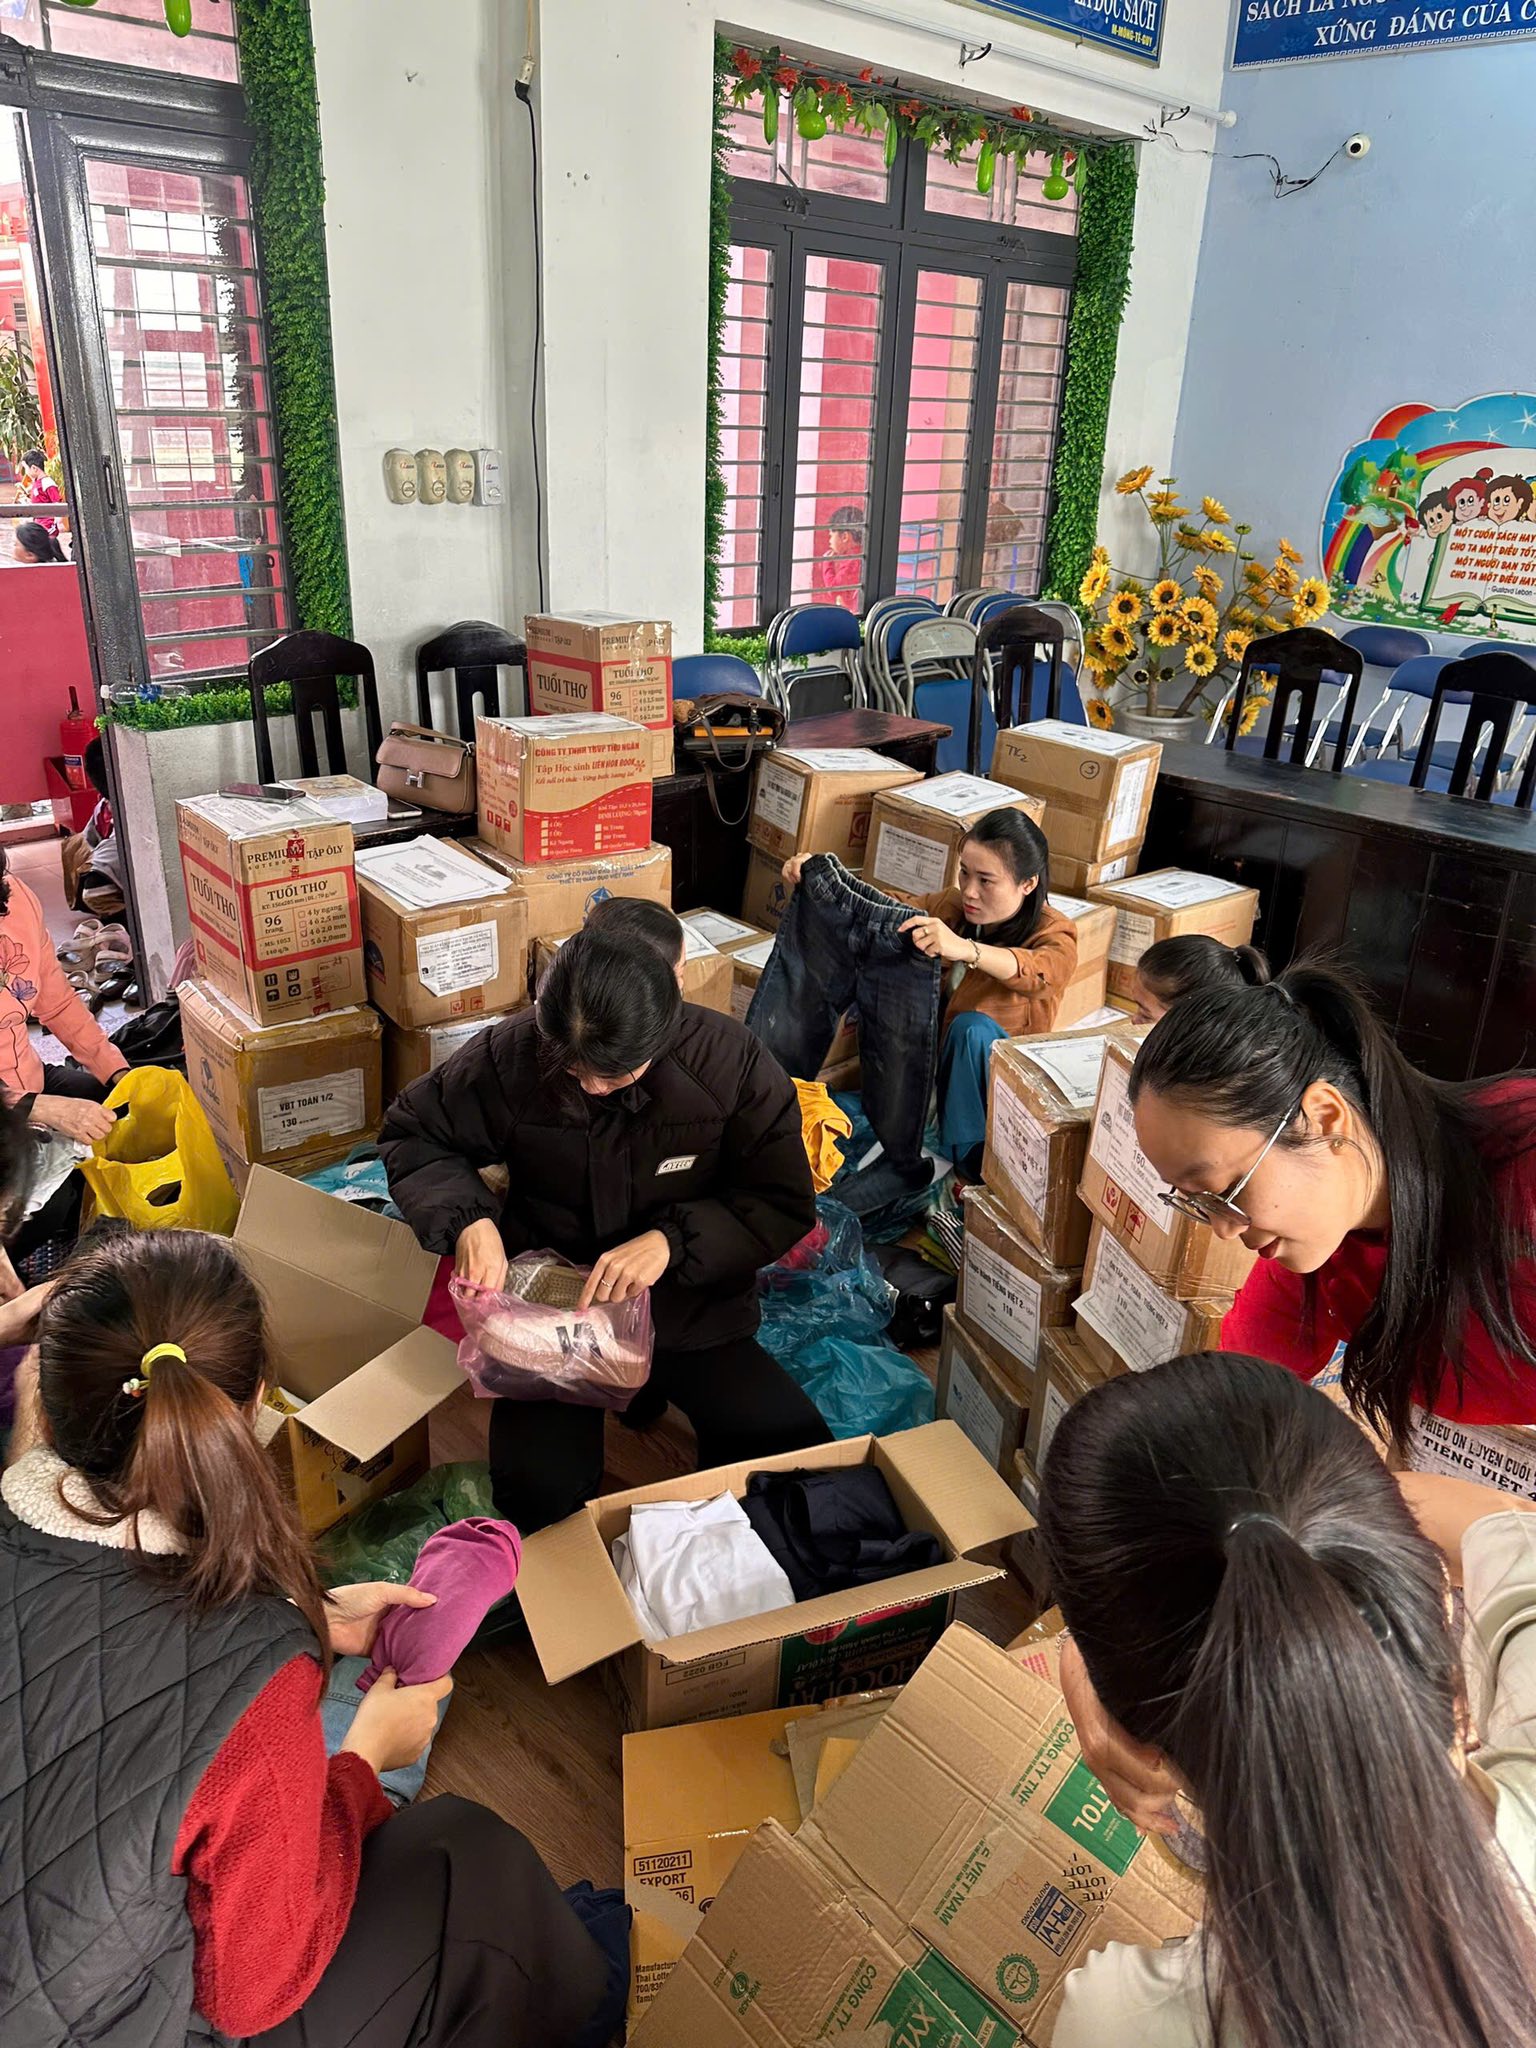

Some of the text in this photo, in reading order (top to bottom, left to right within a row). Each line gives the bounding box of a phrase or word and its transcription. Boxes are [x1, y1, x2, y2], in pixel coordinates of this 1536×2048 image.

[1313, 18, 1376, 46] XỨNG
[1388, 7, 1455, 37] ĐÁNG
[1454, 527, 1536, 543] MỘT CUỐN SÁCH HAY
[1449, 542, 1466, 551] CHO
[1468, 544, 1477, 552] TA
[1478, 544, 1498, 555] MỘT
[1455, 556, 1474, 567] MỘT
[1500, 561, 1519, 572] BẠN
[1450, 570, 1466, 579] CHO
[1468, 571, 1478, 580] TA
[1478, 572, 1498, 583] MỘT
[602, 635, 635, 645] PREMIU
[537, 672, 561, 694] TUỔI
[563, 679, 588, 700] THƠ
[610, 691, 622, 700] 96
[558, 748, 566, 756] TY
[555, 762, 572, 773] Học
[573, 762, 590, 771] sinh
[307, 848, 325, 860] TẬP
[326, 845, 344, 856] ÔLY
[547, 872, 563, 880] CÔNG
[190, 872, 214, 909] TUỔI
[267, 880, 328, 901] TUỔI THƠ
[313, 908, 320, 916] ly
[321, 904, 344, 913] ngang
[265, 915, 282, 927] 96
[265, 926, 284, 934] trang
[279, 1099, 295, 1112] VBT
[321, 1092, 334, 1103] 1/2
[281, 1117, 297, 1129] 130
[992, 1274, 1007, 1298] TIẾNG
[1007, 1289, 1019, 1306] VIỆT
[1423, 1436, 1474, 1470] TIẾNG
[1481, 1465, 1522, 1493] VIỆT
[1505, 1457, 1531, 1481] CUỐI
[683, 1666, 707, 1678] 0222
[788, 1658, 918, 1707] HOCOLAT
[1018, 1723, 1075, 1806] CÔNG TY TNH
[1072, 1784, 1111, 1832] ITOL
[638, 1854, 687, 1871] 51120211
[1062, 1864, 1092, 1877] LOTT
[1068, 1876, 1107, 1891] LOTTE
[939, 1861, 987, 1926] VIỆT NAM
[1082, 1892, 1108, 1902] TTE
[635, 1961, 678, 1973] Manufactur
[636, 1974, 650, 1983] Thai
[849, 1964, 877, 2009] CÔNG
[838, 2008, 853, 2031] TY
